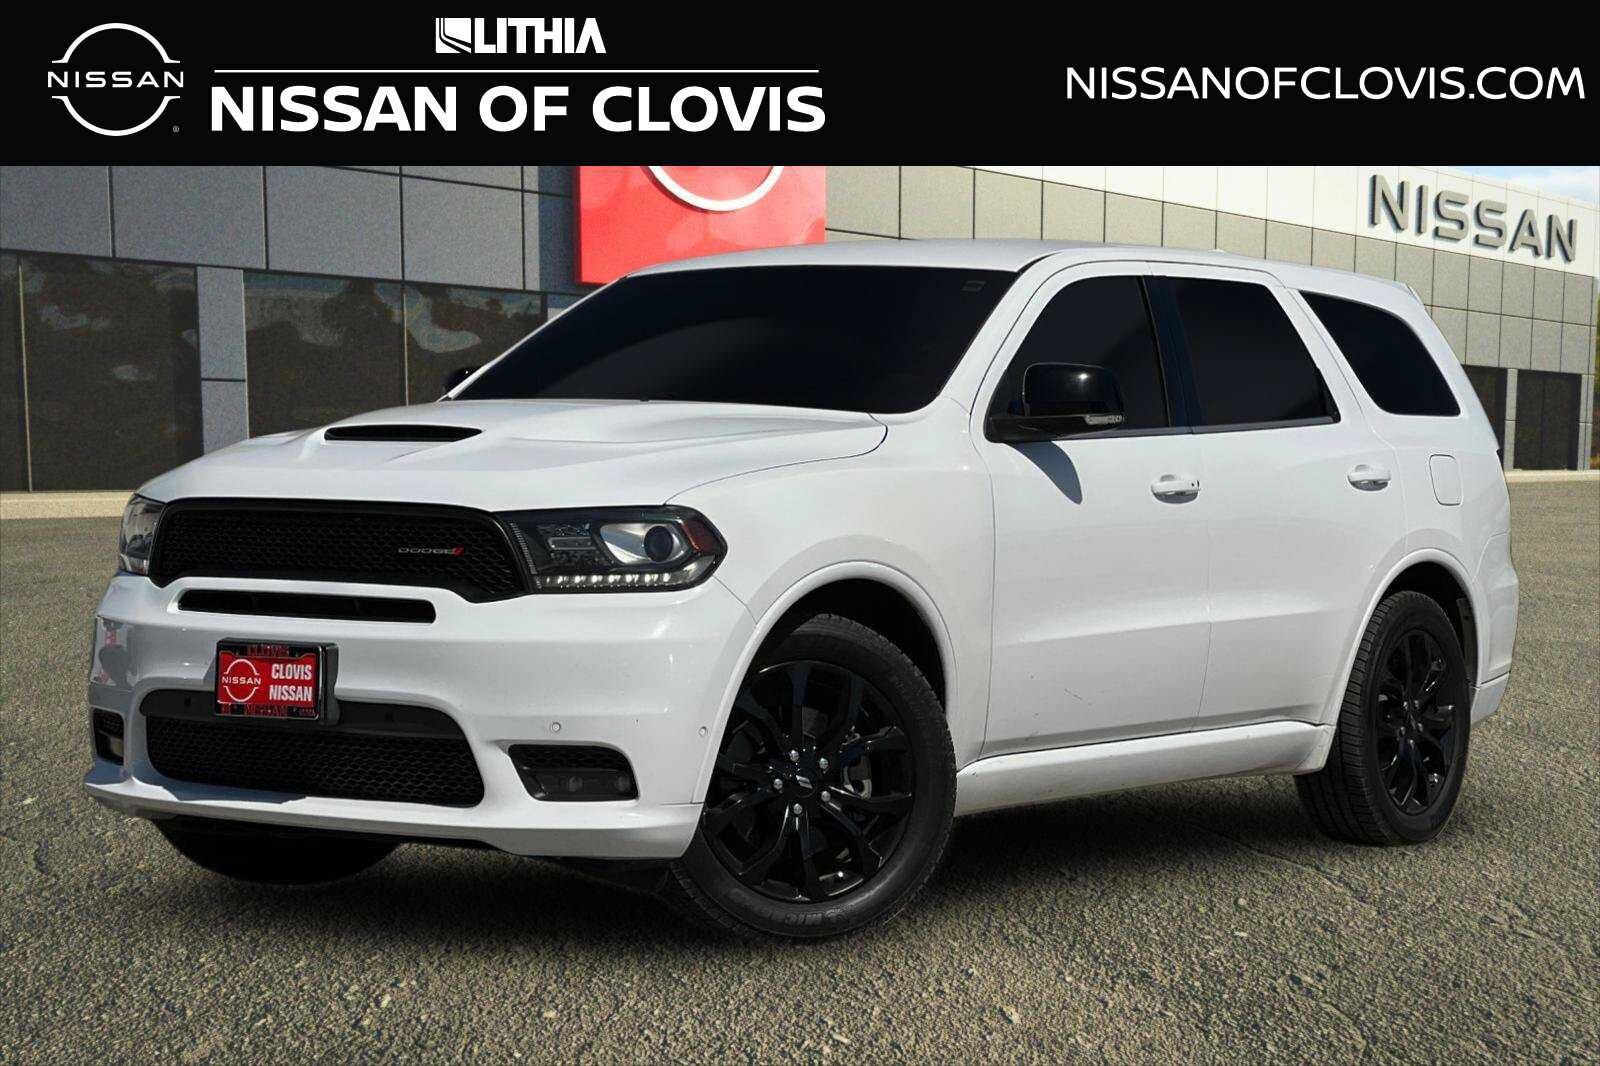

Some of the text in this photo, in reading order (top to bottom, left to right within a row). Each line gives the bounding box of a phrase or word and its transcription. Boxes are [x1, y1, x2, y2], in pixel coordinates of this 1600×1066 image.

[1368, 174, 1577, 263] NISSAN
[271, 663, 312, 680] CLOVIS
[221, 676, 262, 685] NISSAN
[269, 685, 313, 701] NISSAN
